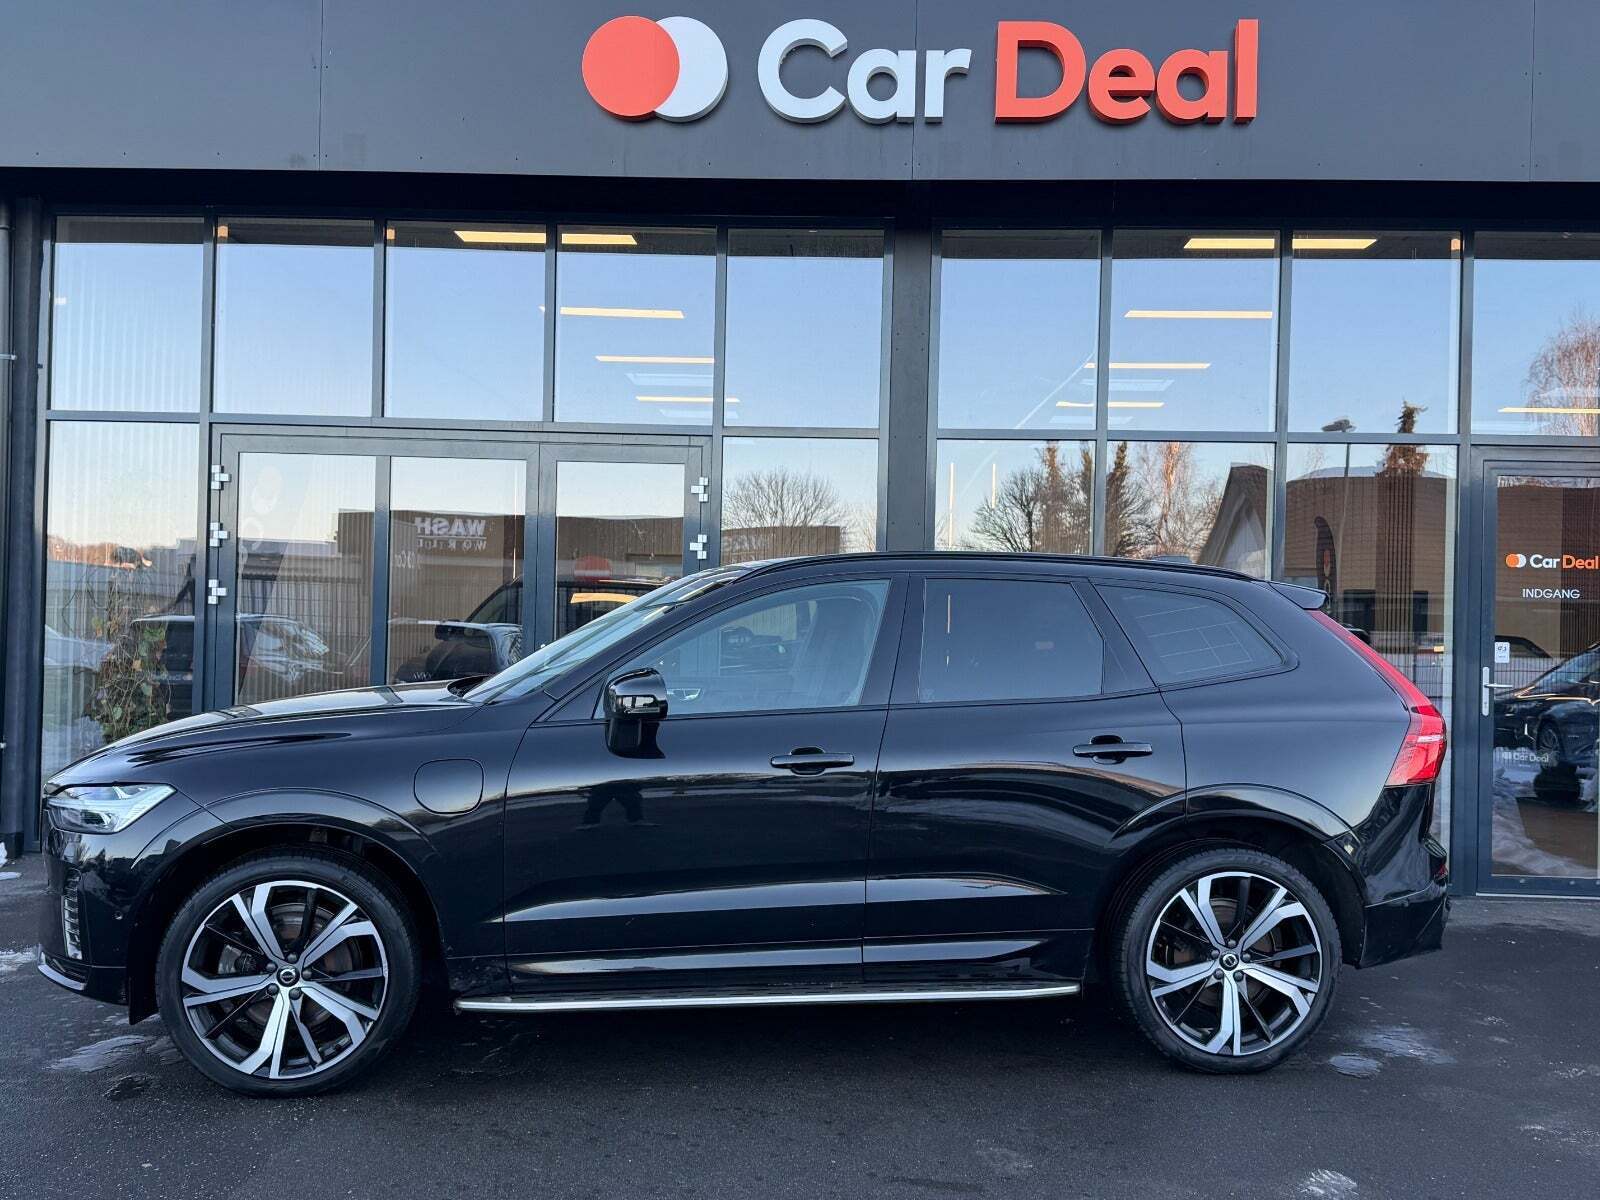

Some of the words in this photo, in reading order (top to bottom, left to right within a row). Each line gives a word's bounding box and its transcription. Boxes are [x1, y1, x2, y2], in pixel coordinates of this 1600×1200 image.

[757, 19, 972, 124] Car
[995, 18, 1259, 124] Deal
[1529, 554, 1561, 568] Car
[1562, 555, 1599, 569] Deal
[1522, 588, 1580, 599] INDGANG
